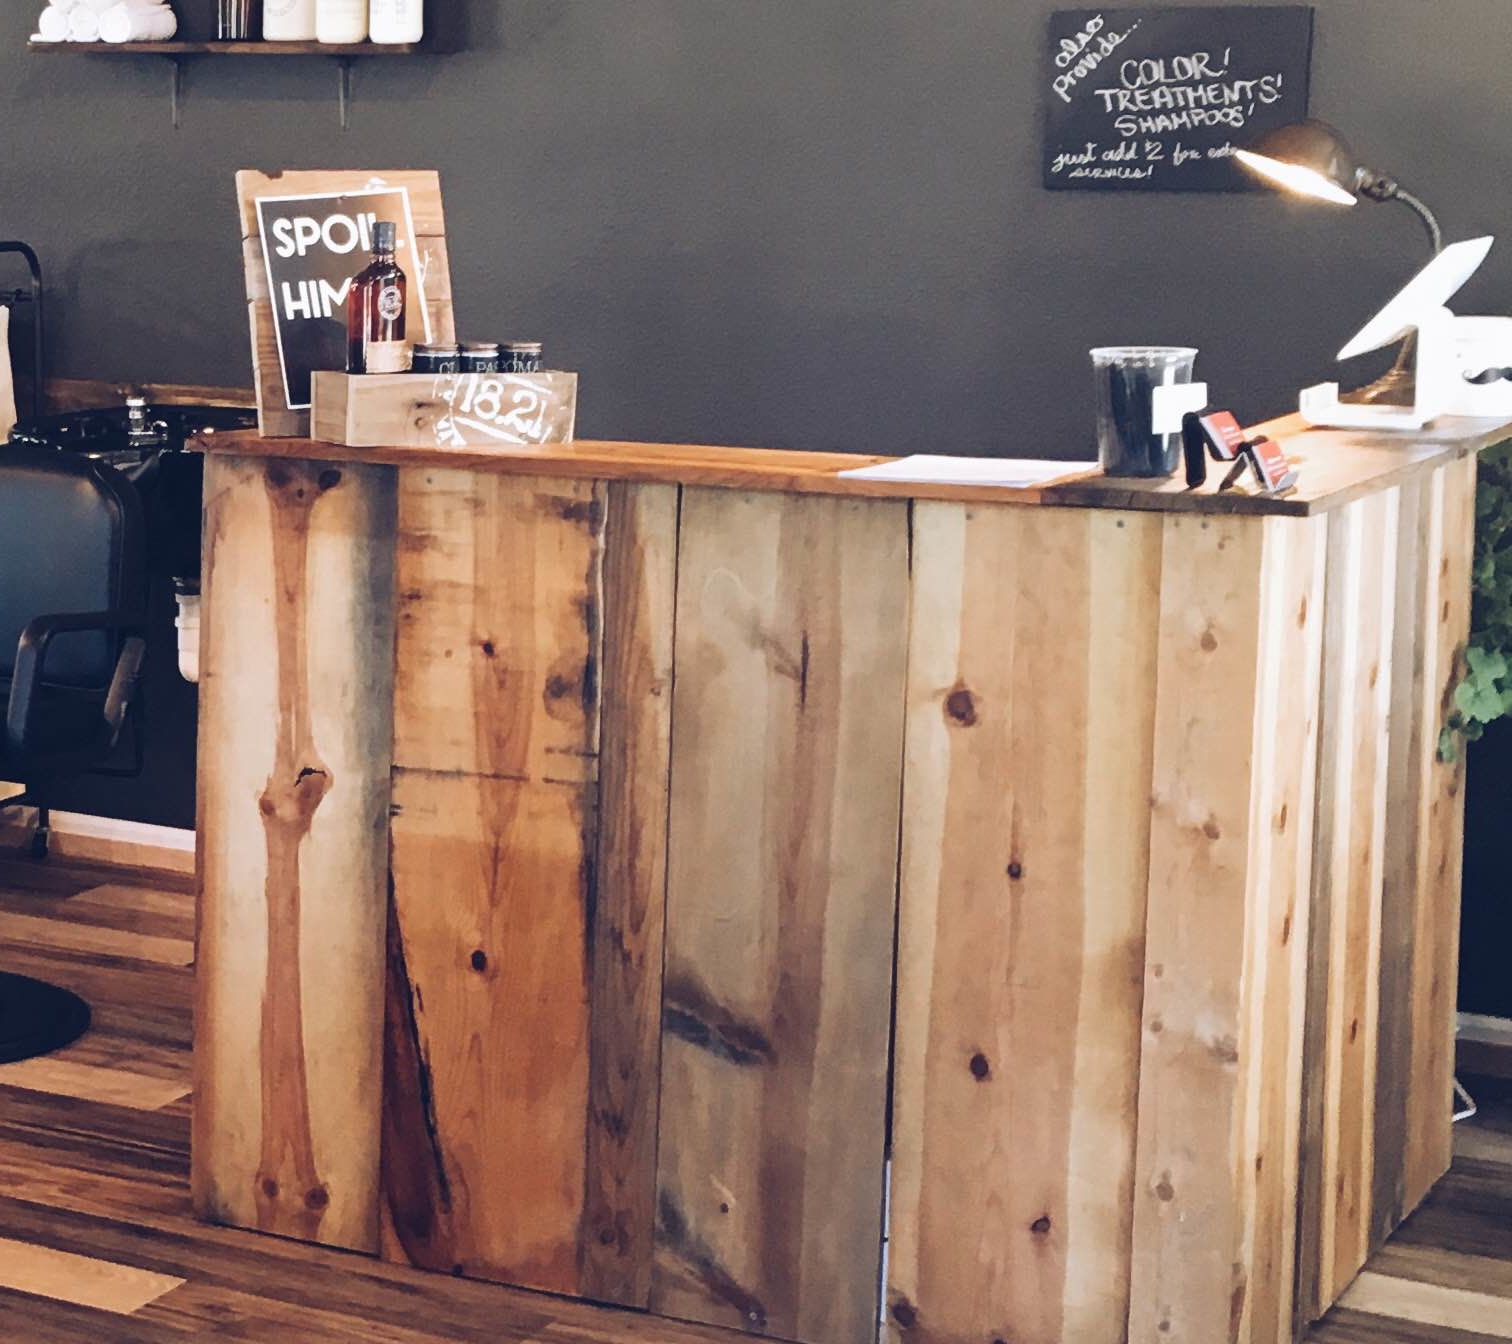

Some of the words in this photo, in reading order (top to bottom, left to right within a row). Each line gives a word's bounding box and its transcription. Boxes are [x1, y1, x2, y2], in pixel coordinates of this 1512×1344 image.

[1120, 47, 1231, 89] COLOR!
[1094, 72, 1283, 113] TREATMENTS!
[1114, 102, 1255, 137] SHAMPOOS!
[1051, 142, 1097, 173] just
[1101, 141, 1138, 161] add
